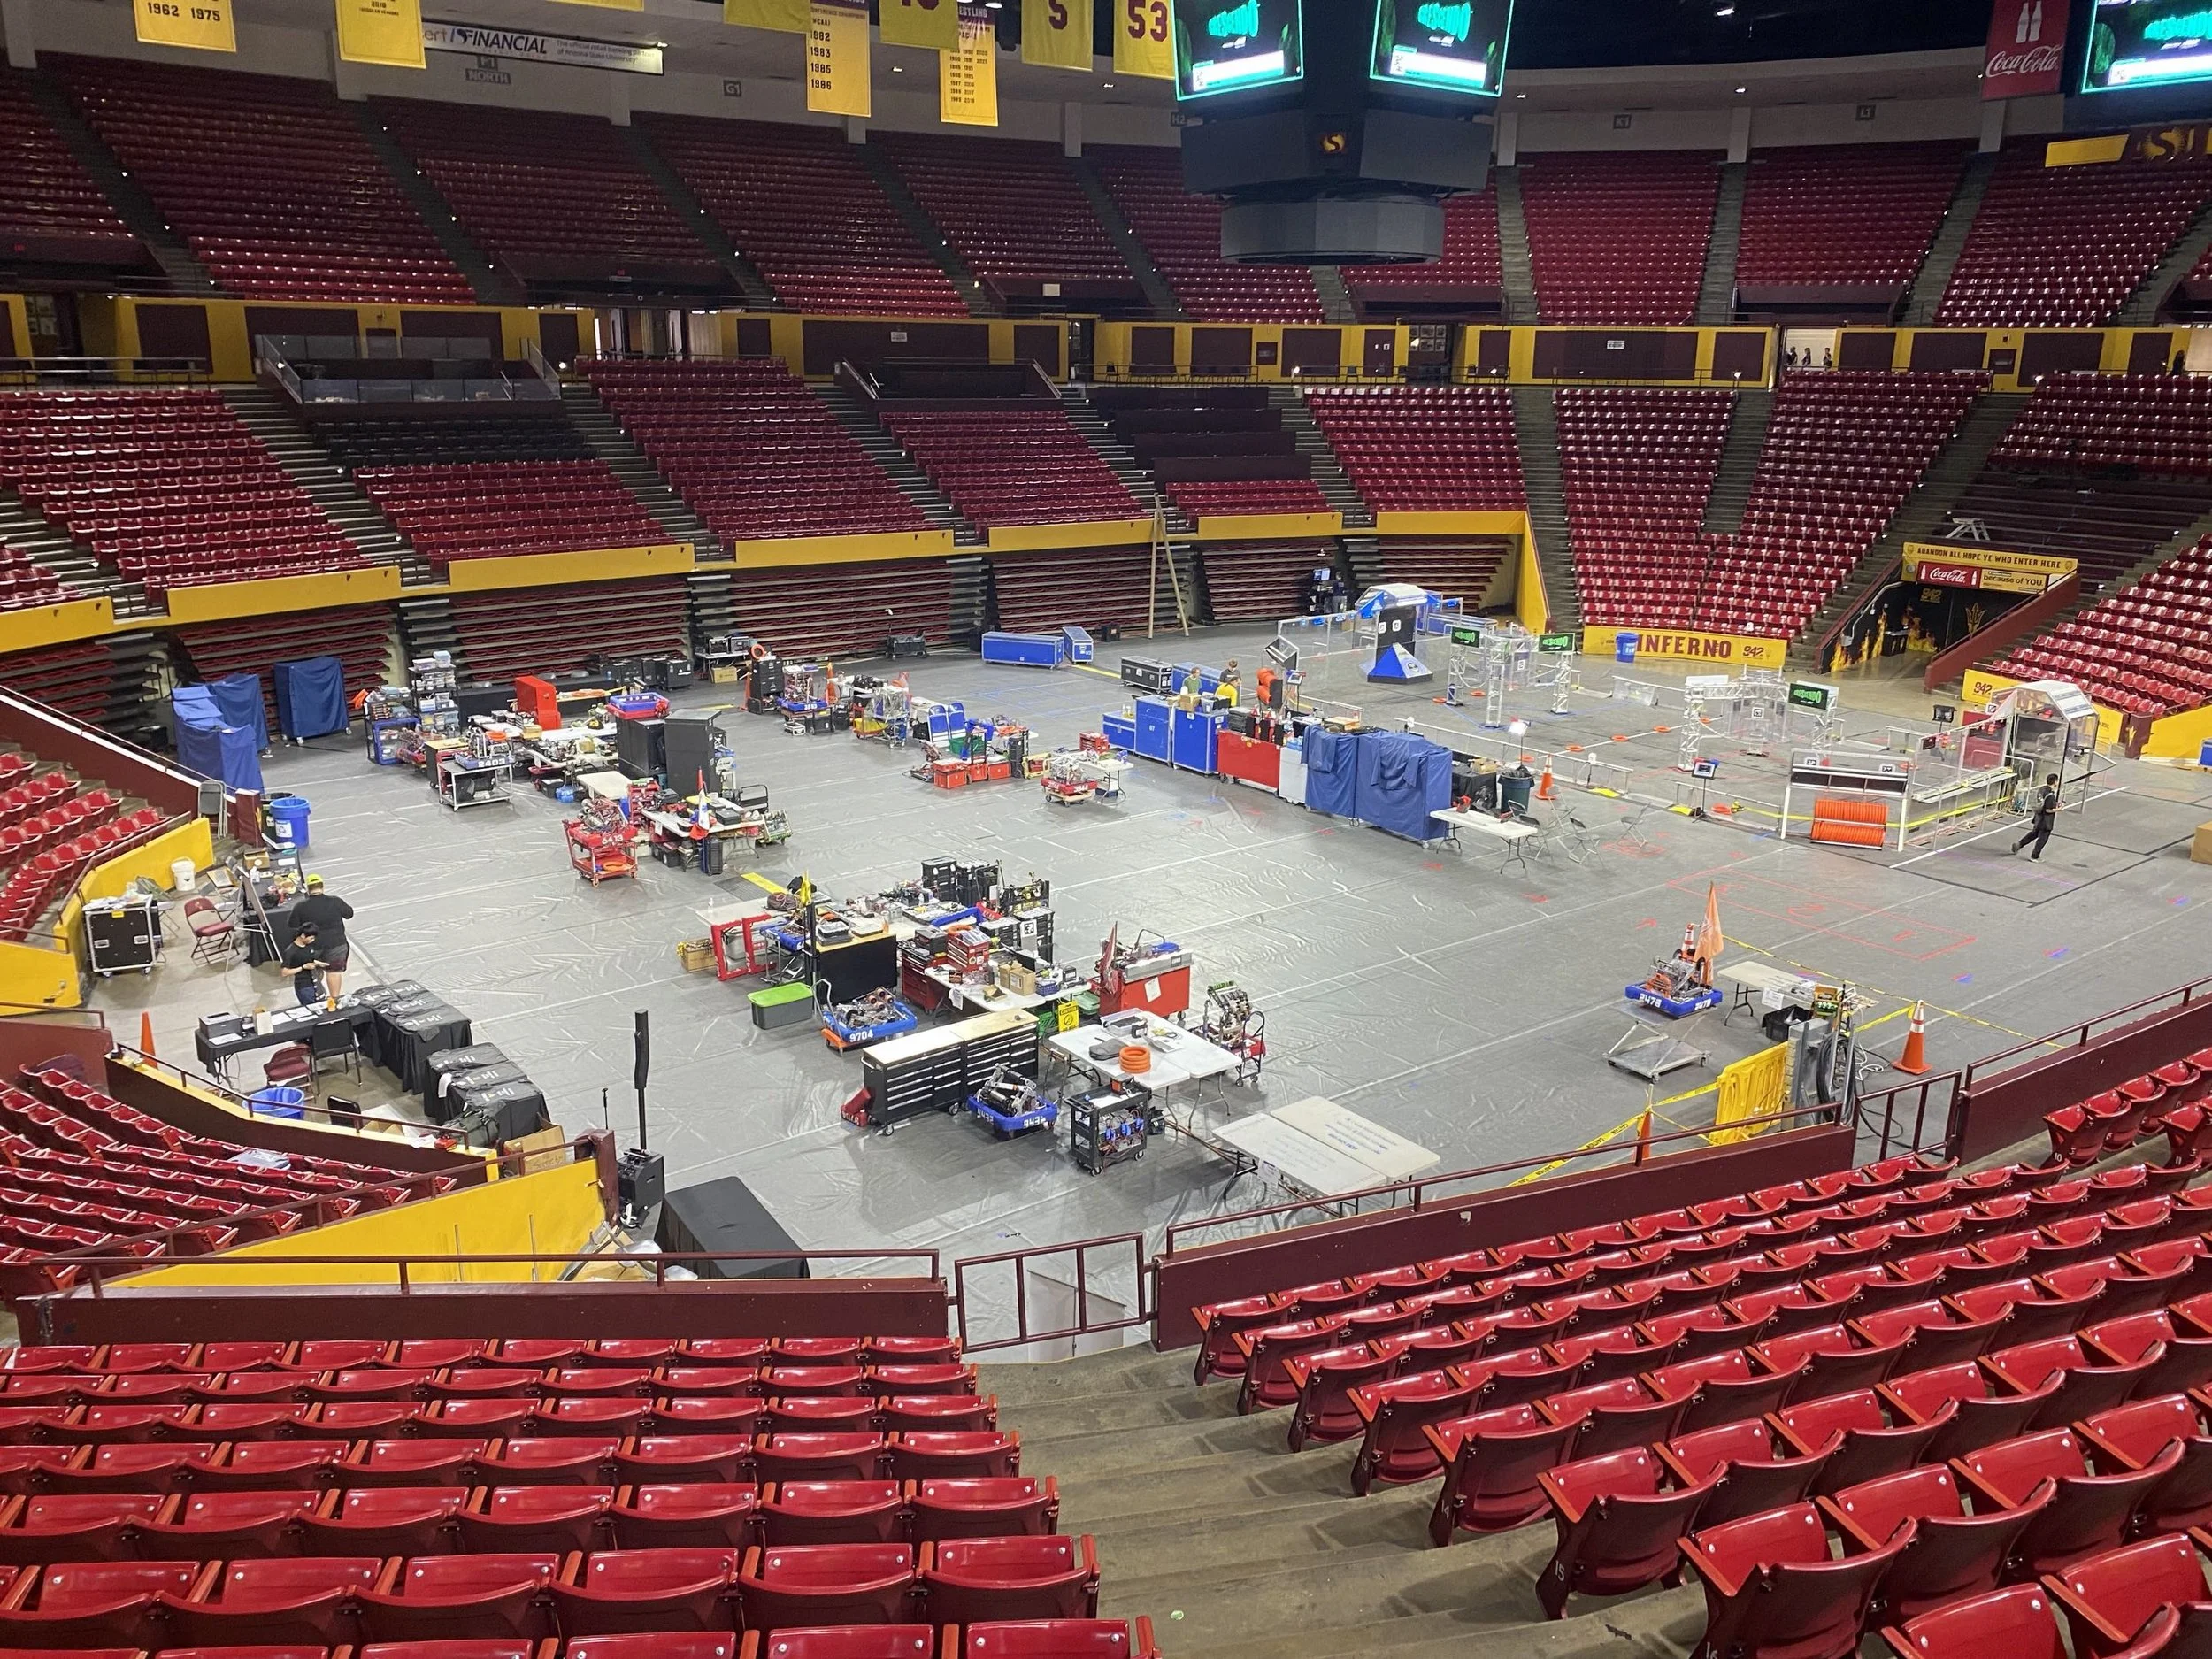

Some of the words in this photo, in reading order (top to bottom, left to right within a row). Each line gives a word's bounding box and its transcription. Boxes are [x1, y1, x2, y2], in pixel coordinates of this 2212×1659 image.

[147, 3, 179, 17] 1962
[191, 8, 220, 21] 1975
[1127, 0, 1168, 42] 53
[423, 28, 447, 42] ert
[463, 29, 548, 54] FINANCIAL
[810, 30, 831, 42] 1982
[810, 47, 831, 58] 1983
[811, 63, 831, 73] 1985
[1985, 44, 2063, 78] Coca-Cola
[811, 79, 832, 89] 1986
[1917, 547, 1947, 557] ABANDON
[1962, 552, 1980, 561] HOPE
[2014, 557, 2039, 566] ENTER
[2040, 559, 2061, 568] HERE
[1984, 574, 2015, 584] because
[1637, 634, 1732, 659] INFERNO
[1742, 645, 1764, 657] 942
[1973, 681, 1993, 695] 942
[479, 757, 505, 767] 2403
[1639, 993, 1663, 1008] 2478
[849, 1029, 873, 1042] 9704
[1553, 1560, 1566, 1585] 15
